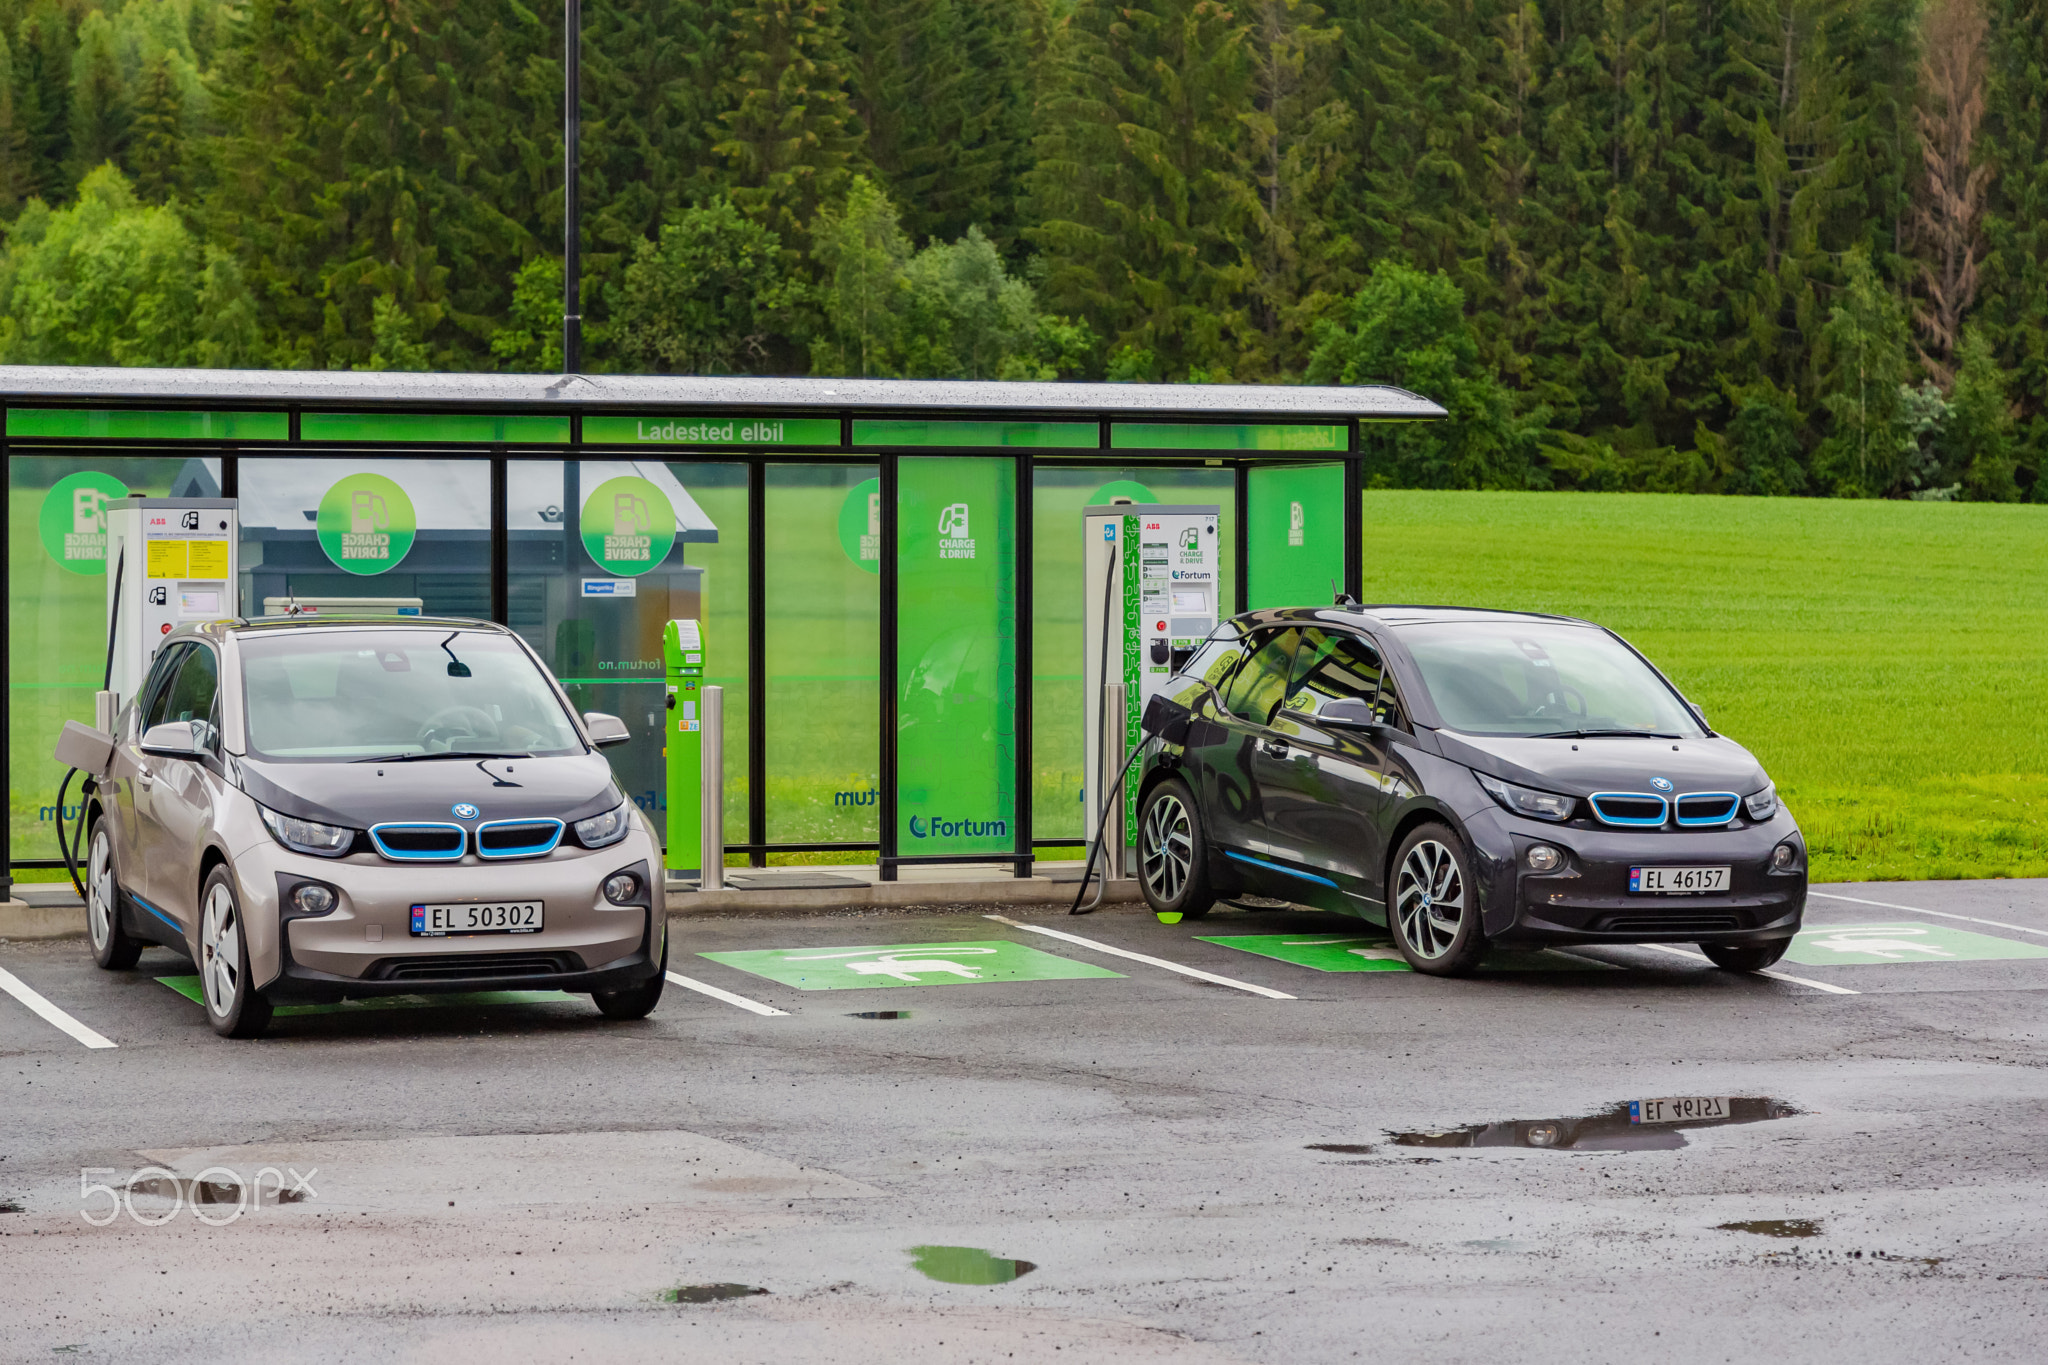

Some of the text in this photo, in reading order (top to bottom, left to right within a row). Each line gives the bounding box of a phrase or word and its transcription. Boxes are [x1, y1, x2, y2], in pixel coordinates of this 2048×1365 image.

[637, 421, 784, 442] Ladested elbil
[939, 539, 975, 549] CHARGE
[939, 549, 975, 559] & DRIVE
[1180, 571, 1211, 580] Fortum
[931, 816, 1007, 838] Fortum
[1646, 870, 1724, 889] EL 46157
[432, 905, 535, 929] EL 50302
